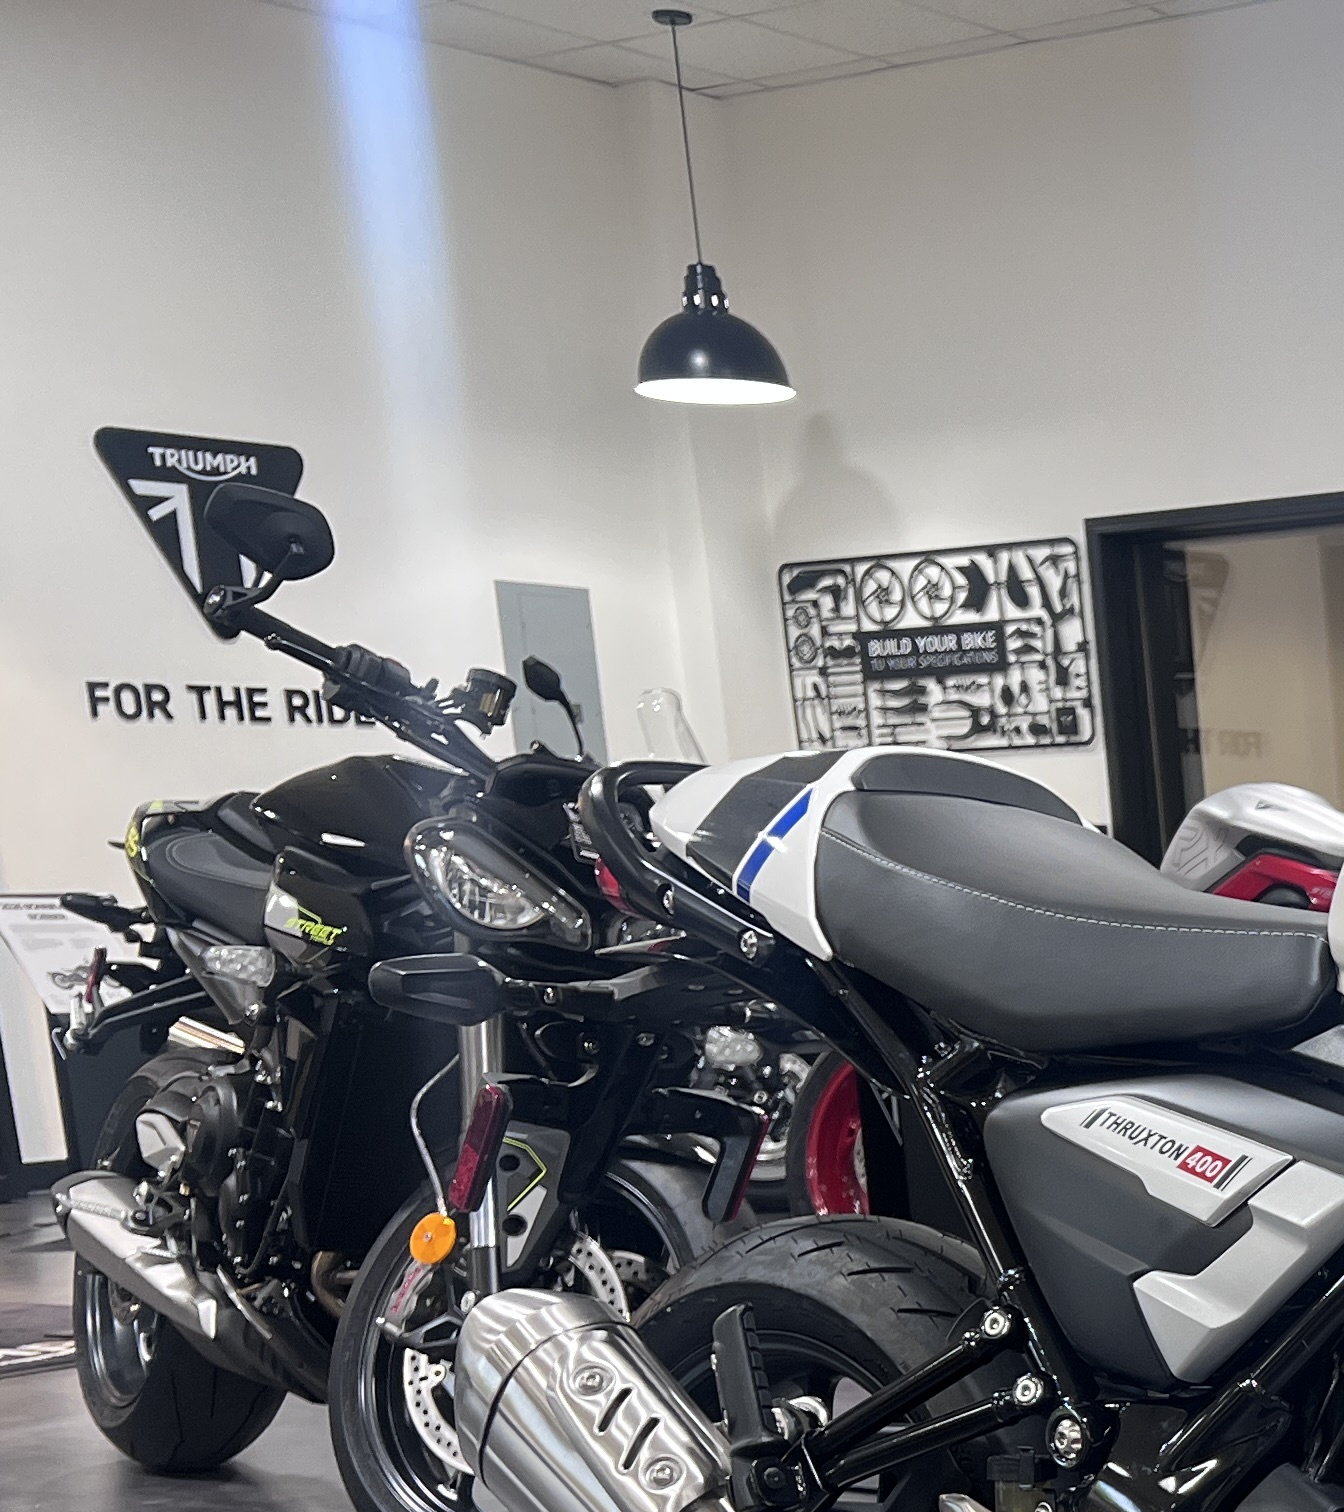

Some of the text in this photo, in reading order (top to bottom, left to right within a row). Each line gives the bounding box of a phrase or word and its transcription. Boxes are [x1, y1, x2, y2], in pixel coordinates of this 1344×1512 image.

[147, 446, 258, 481] TRIUMPH
[868, 630, 997, 657] BUILD YOUR BIKE
[85, 681, 174, 722] FOR
[186, 683, 272, 724] THE
[1100, 1111, 1222, 1178] THRUXTON 400
